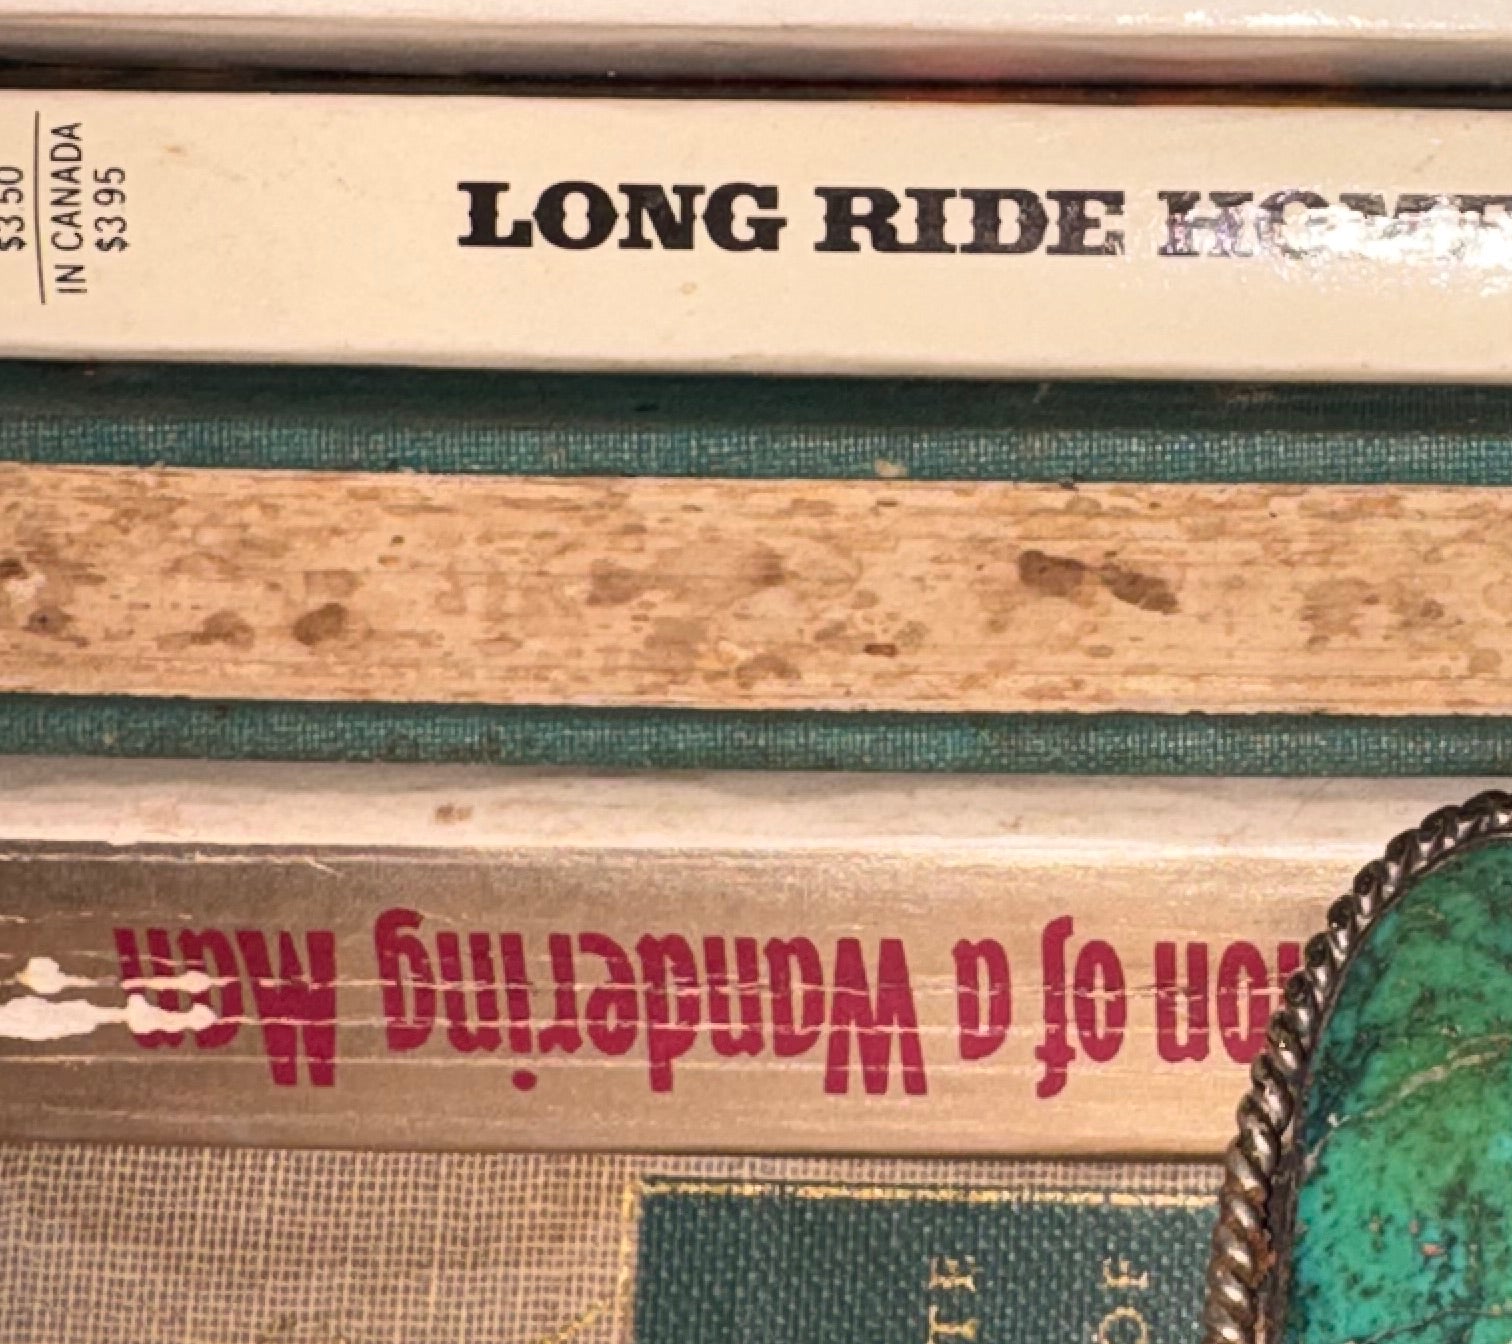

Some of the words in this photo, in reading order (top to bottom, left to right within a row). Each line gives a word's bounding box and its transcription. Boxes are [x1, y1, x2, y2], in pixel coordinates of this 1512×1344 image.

[50, 123, 83, 251] CANADA
[93, 167, 129, 252] $3.95
[456, 182, 786, 251] LONG
[814, 188, 1125, 255] RIDE
[54, 264, 88, 294] IN
[113, 928, 335, 1087] Man
[375, 908, 928, 1096] Wandering
[952, 938, 1012, 1059] a
[1035, 915, 1127, 1099] of
